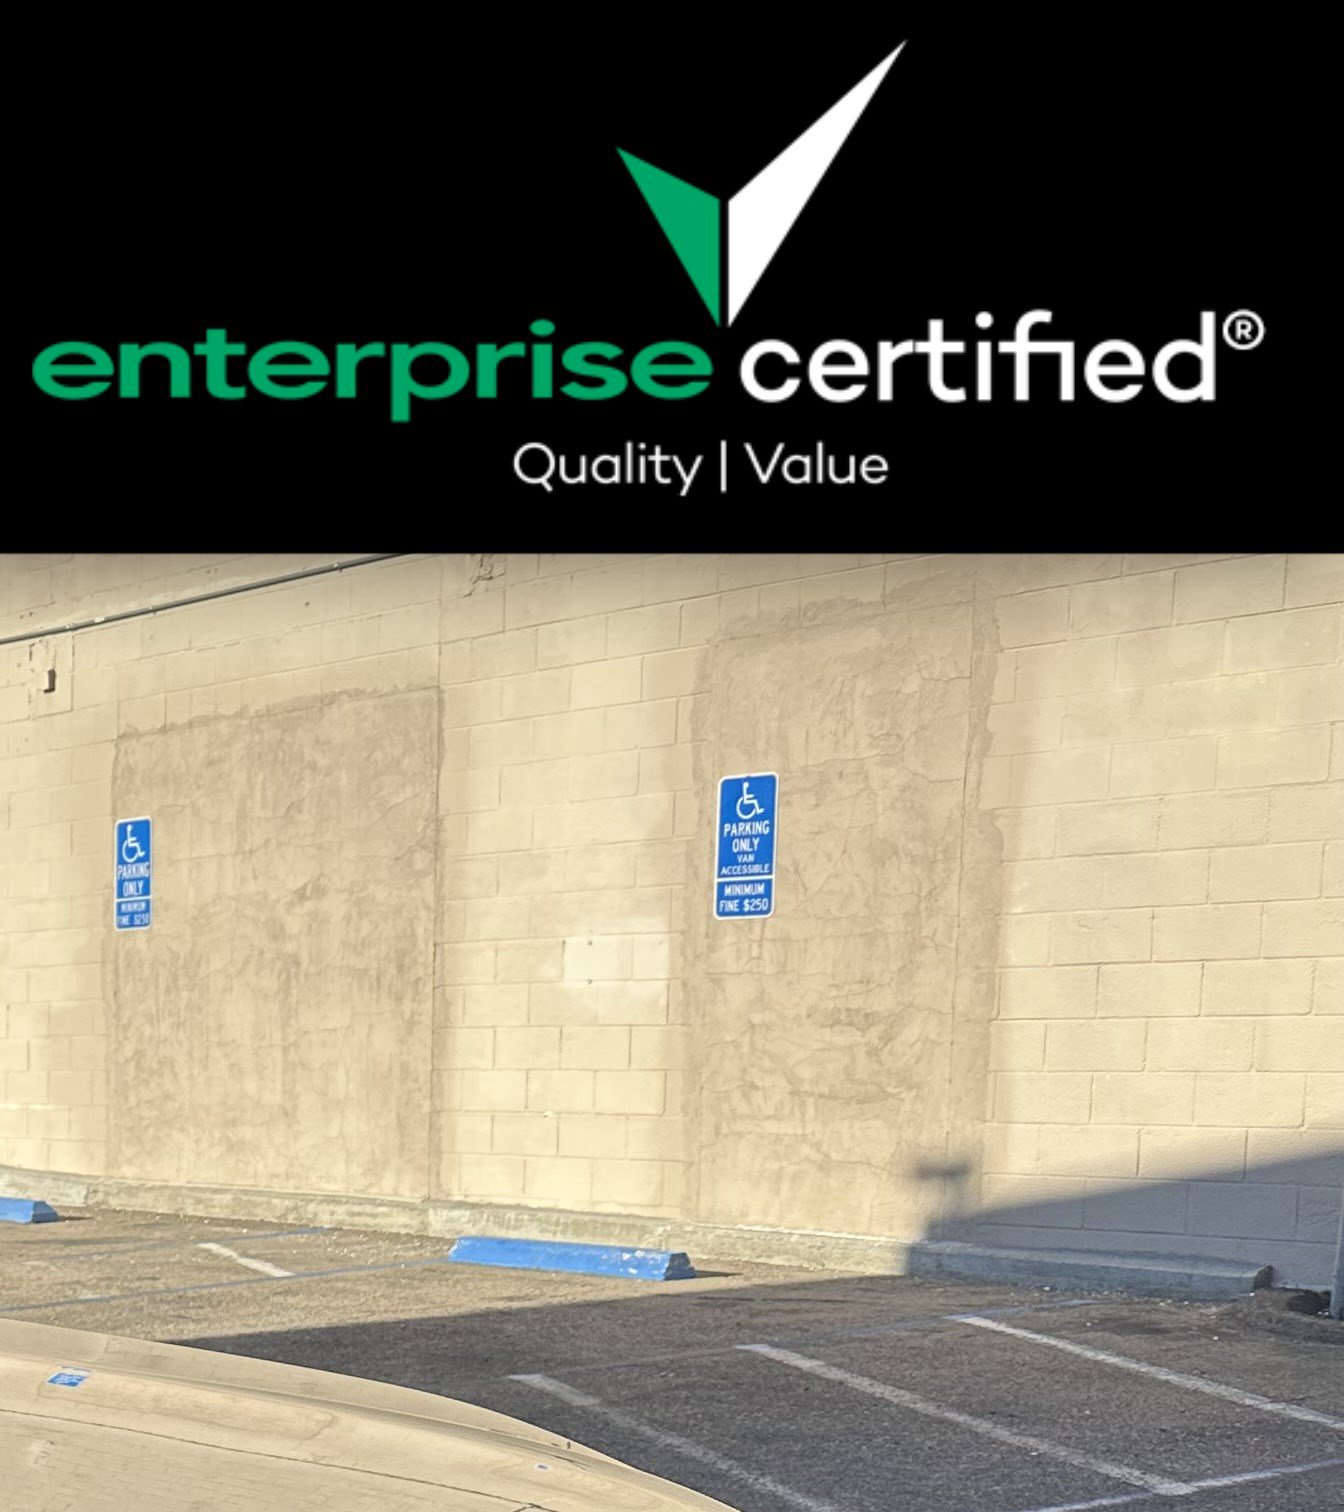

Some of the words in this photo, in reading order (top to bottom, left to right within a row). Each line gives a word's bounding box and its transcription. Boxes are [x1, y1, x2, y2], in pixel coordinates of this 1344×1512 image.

[723, 820, 770, 838] PARKING
[732, 837, 760, 853] ONLY
[737, 853, 754, 863] VAN
[117, 862, 150, 879] PARKING
[720, 863, 770, 876] ACCESSIBLE
[122, 880, 144, 897] ONLY
[724, 883, 765, 897] MINIMUM
[719, 899, 740, 913] FINE
[743, 898, 769, 912] $250
